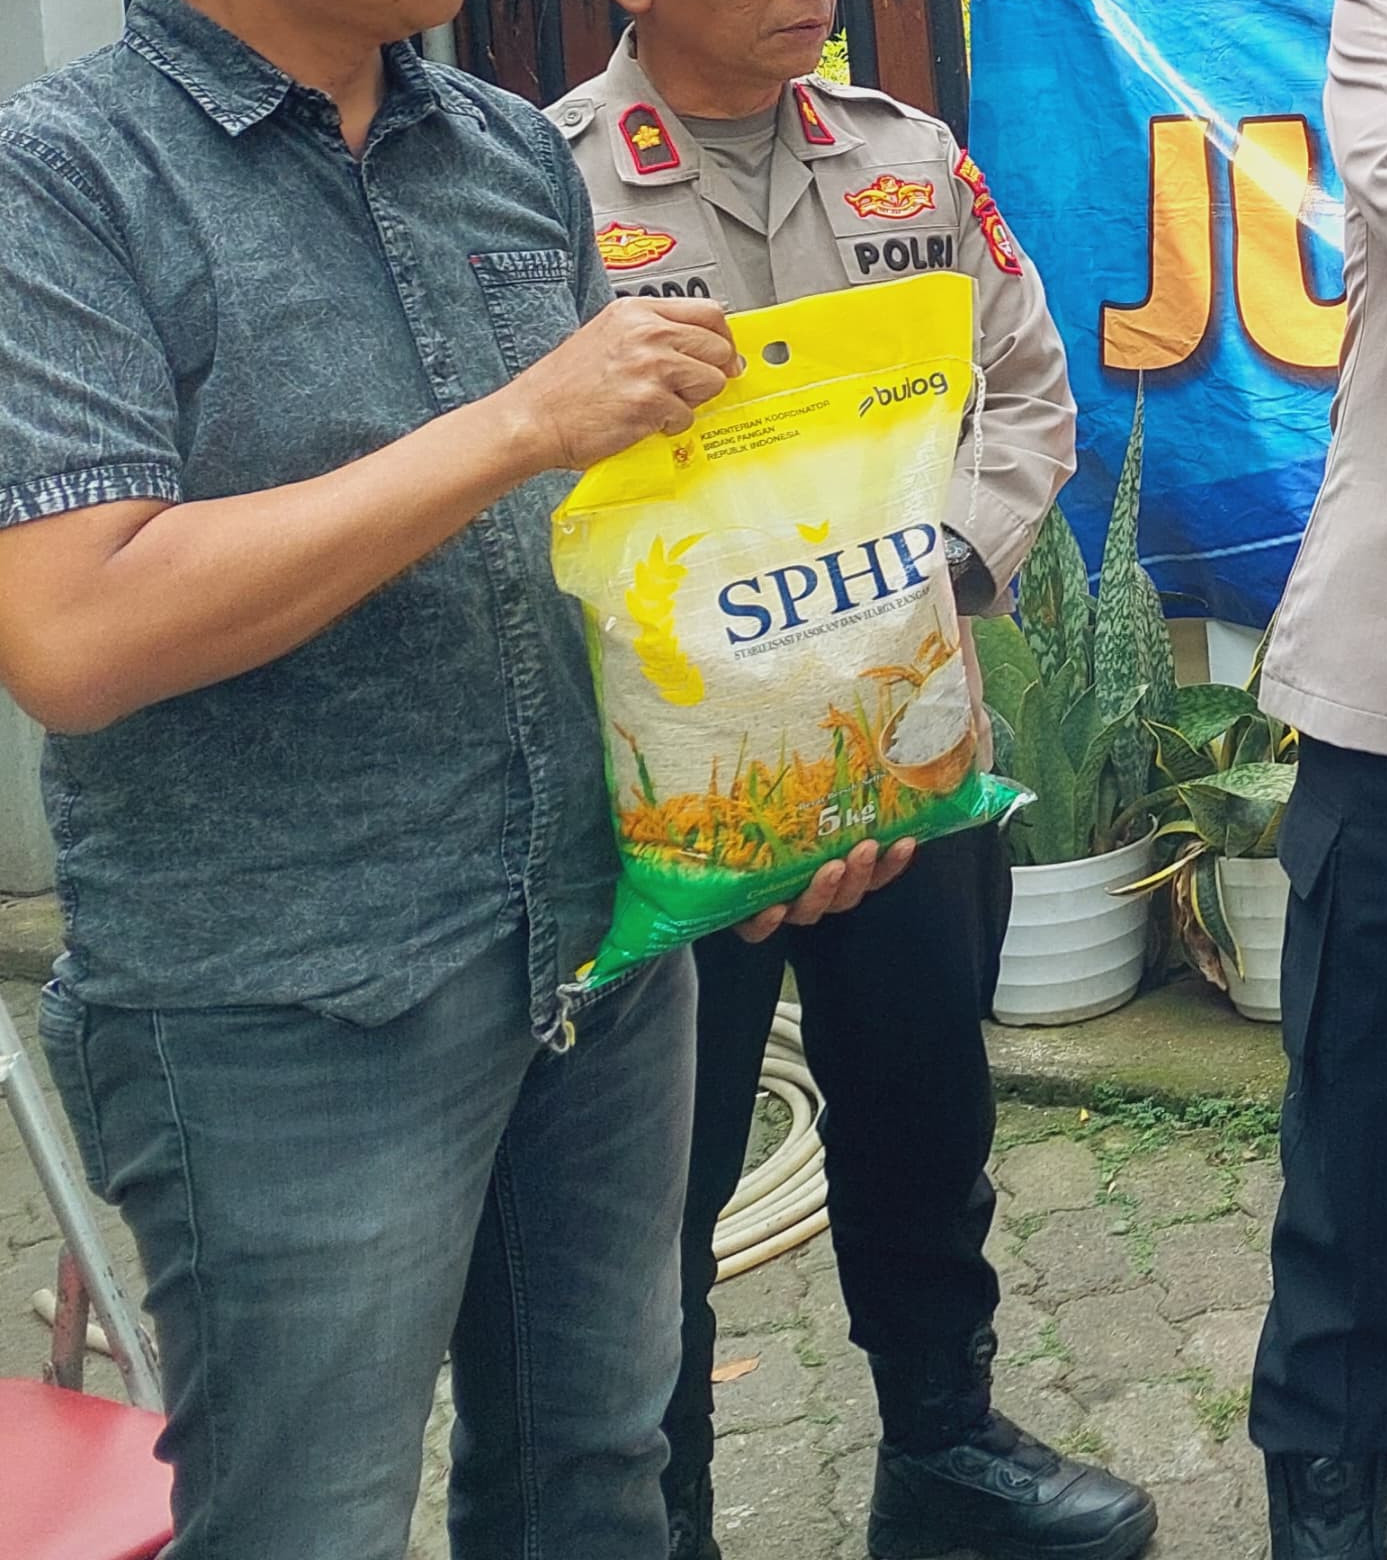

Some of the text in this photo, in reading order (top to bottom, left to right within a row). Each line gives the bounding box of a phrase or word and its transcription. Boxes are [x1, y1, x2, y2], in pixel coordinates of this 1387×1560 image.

[853, 234, 953, 275] POLRI
[873, 371, 948, 406] bulog
[717, 522, 937, 646] SPHP
[817, 801, 877, 837] 5 kg
